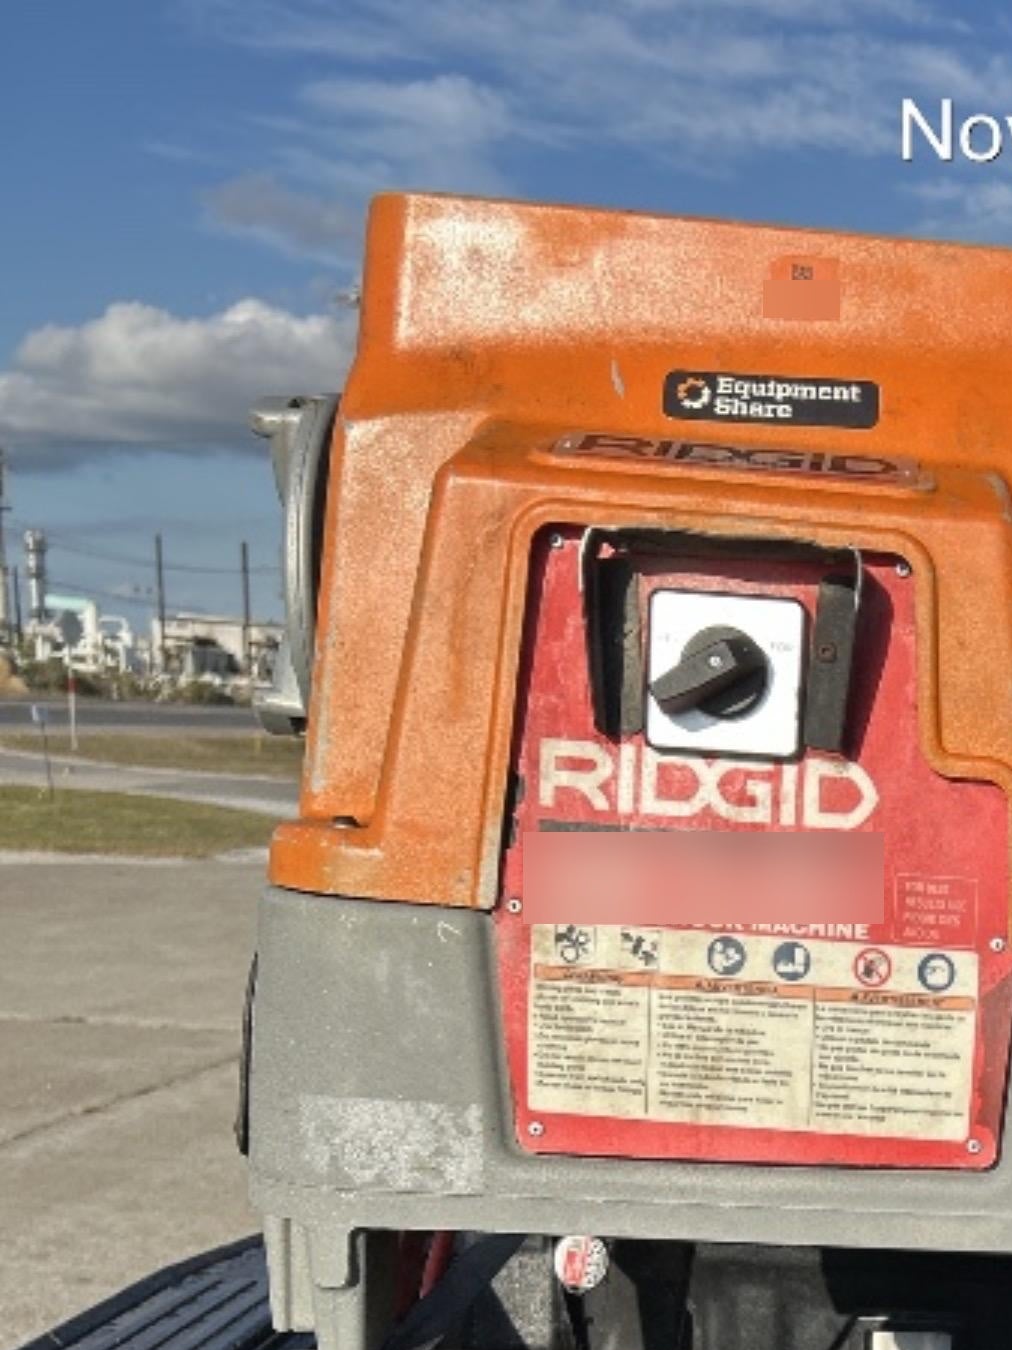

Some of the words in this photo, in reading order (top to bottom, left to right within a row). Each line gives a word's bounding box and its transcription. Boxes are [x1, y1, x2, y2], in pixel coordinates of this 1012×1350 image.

[715, 376, 862, 403] Equipment
[713, 396, 793, 418] Share
[577, 433, 898, 475] RIDGID
[538, 738, 880, 831] RIDGID
